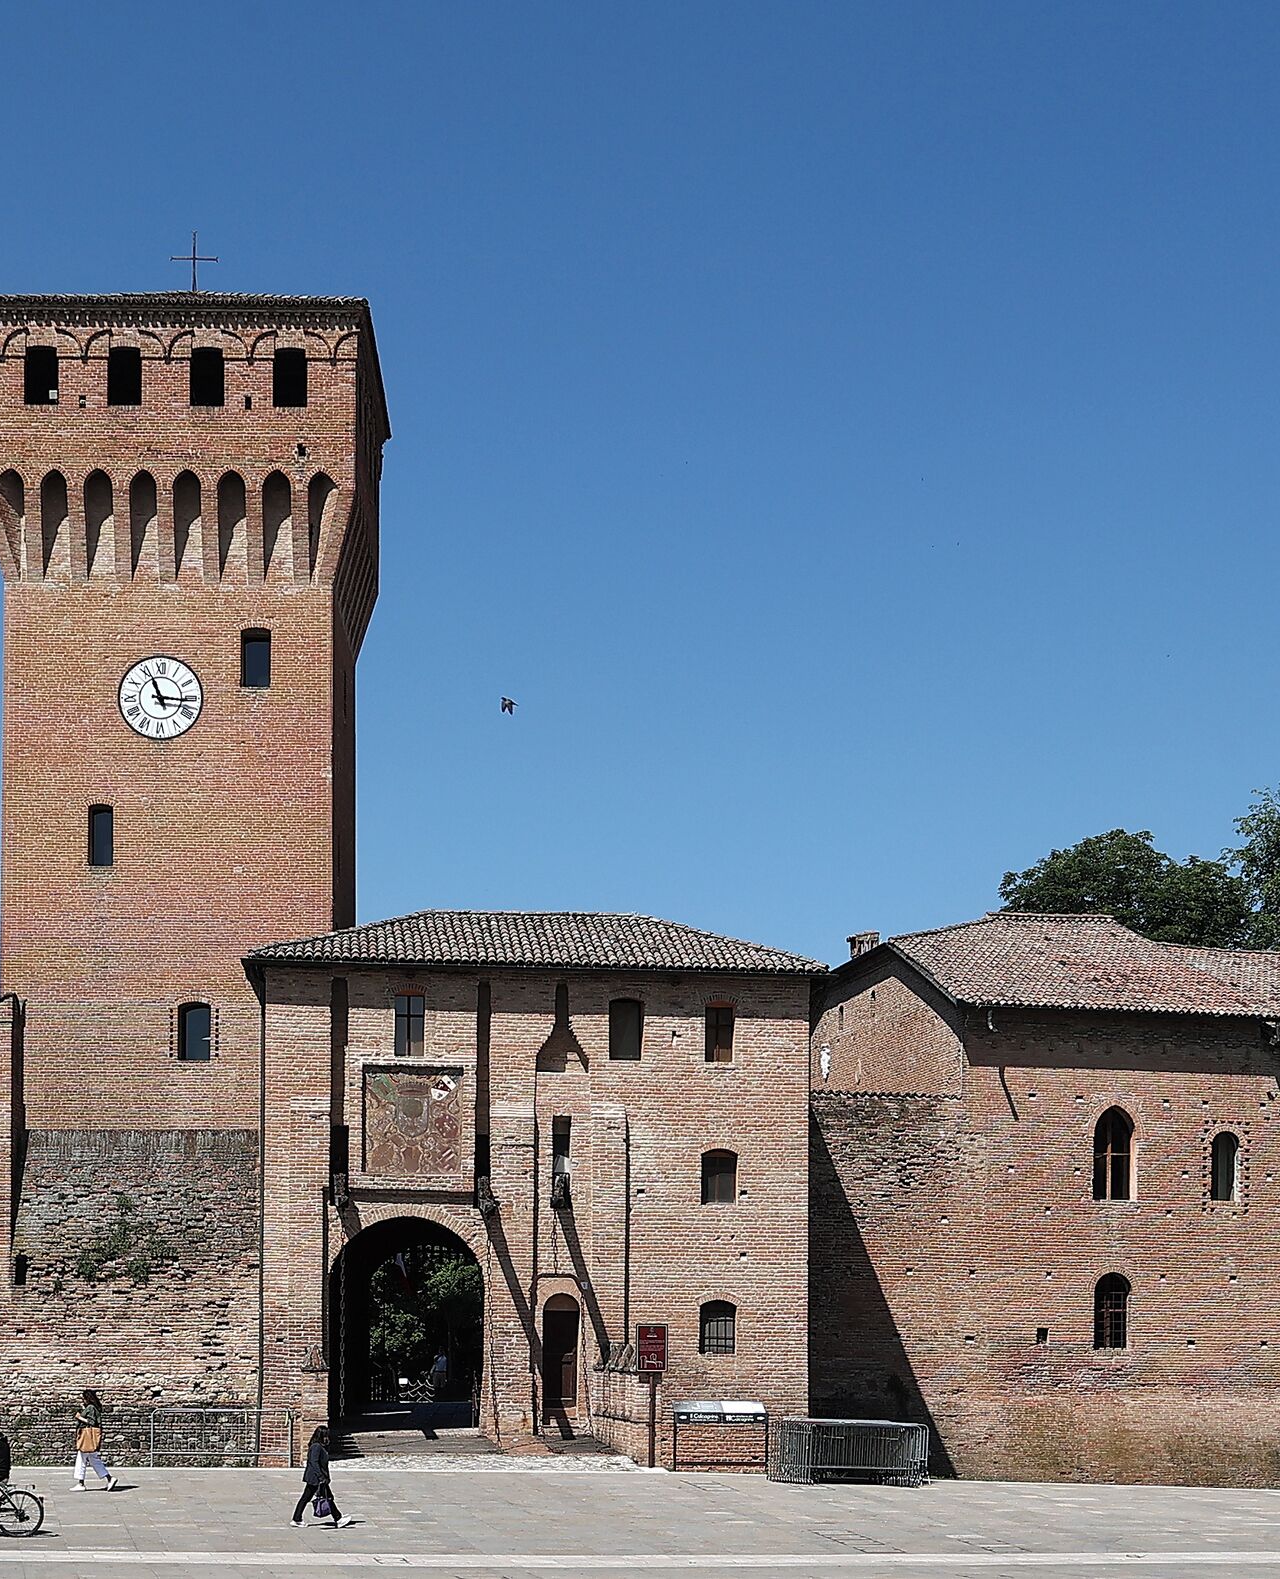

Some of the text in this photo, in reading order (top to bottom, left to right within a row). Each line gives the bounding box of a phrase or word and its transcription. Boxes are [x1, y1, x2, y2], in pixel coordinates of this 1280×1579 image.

[156, 662, 166, 674] XII
[173, 667, 180, 677] I
[128, 678, 141, 689] X
[181, 679, 193, 687] II
[124, 694, 136, 702] IX
[127, 706, 141, 721] VIII
[181, 707, 193, 720] IIII
[139, 717, 150, 731] VII
[156, 722, 165, 734] VI
[172, 719, 181, 731] V
